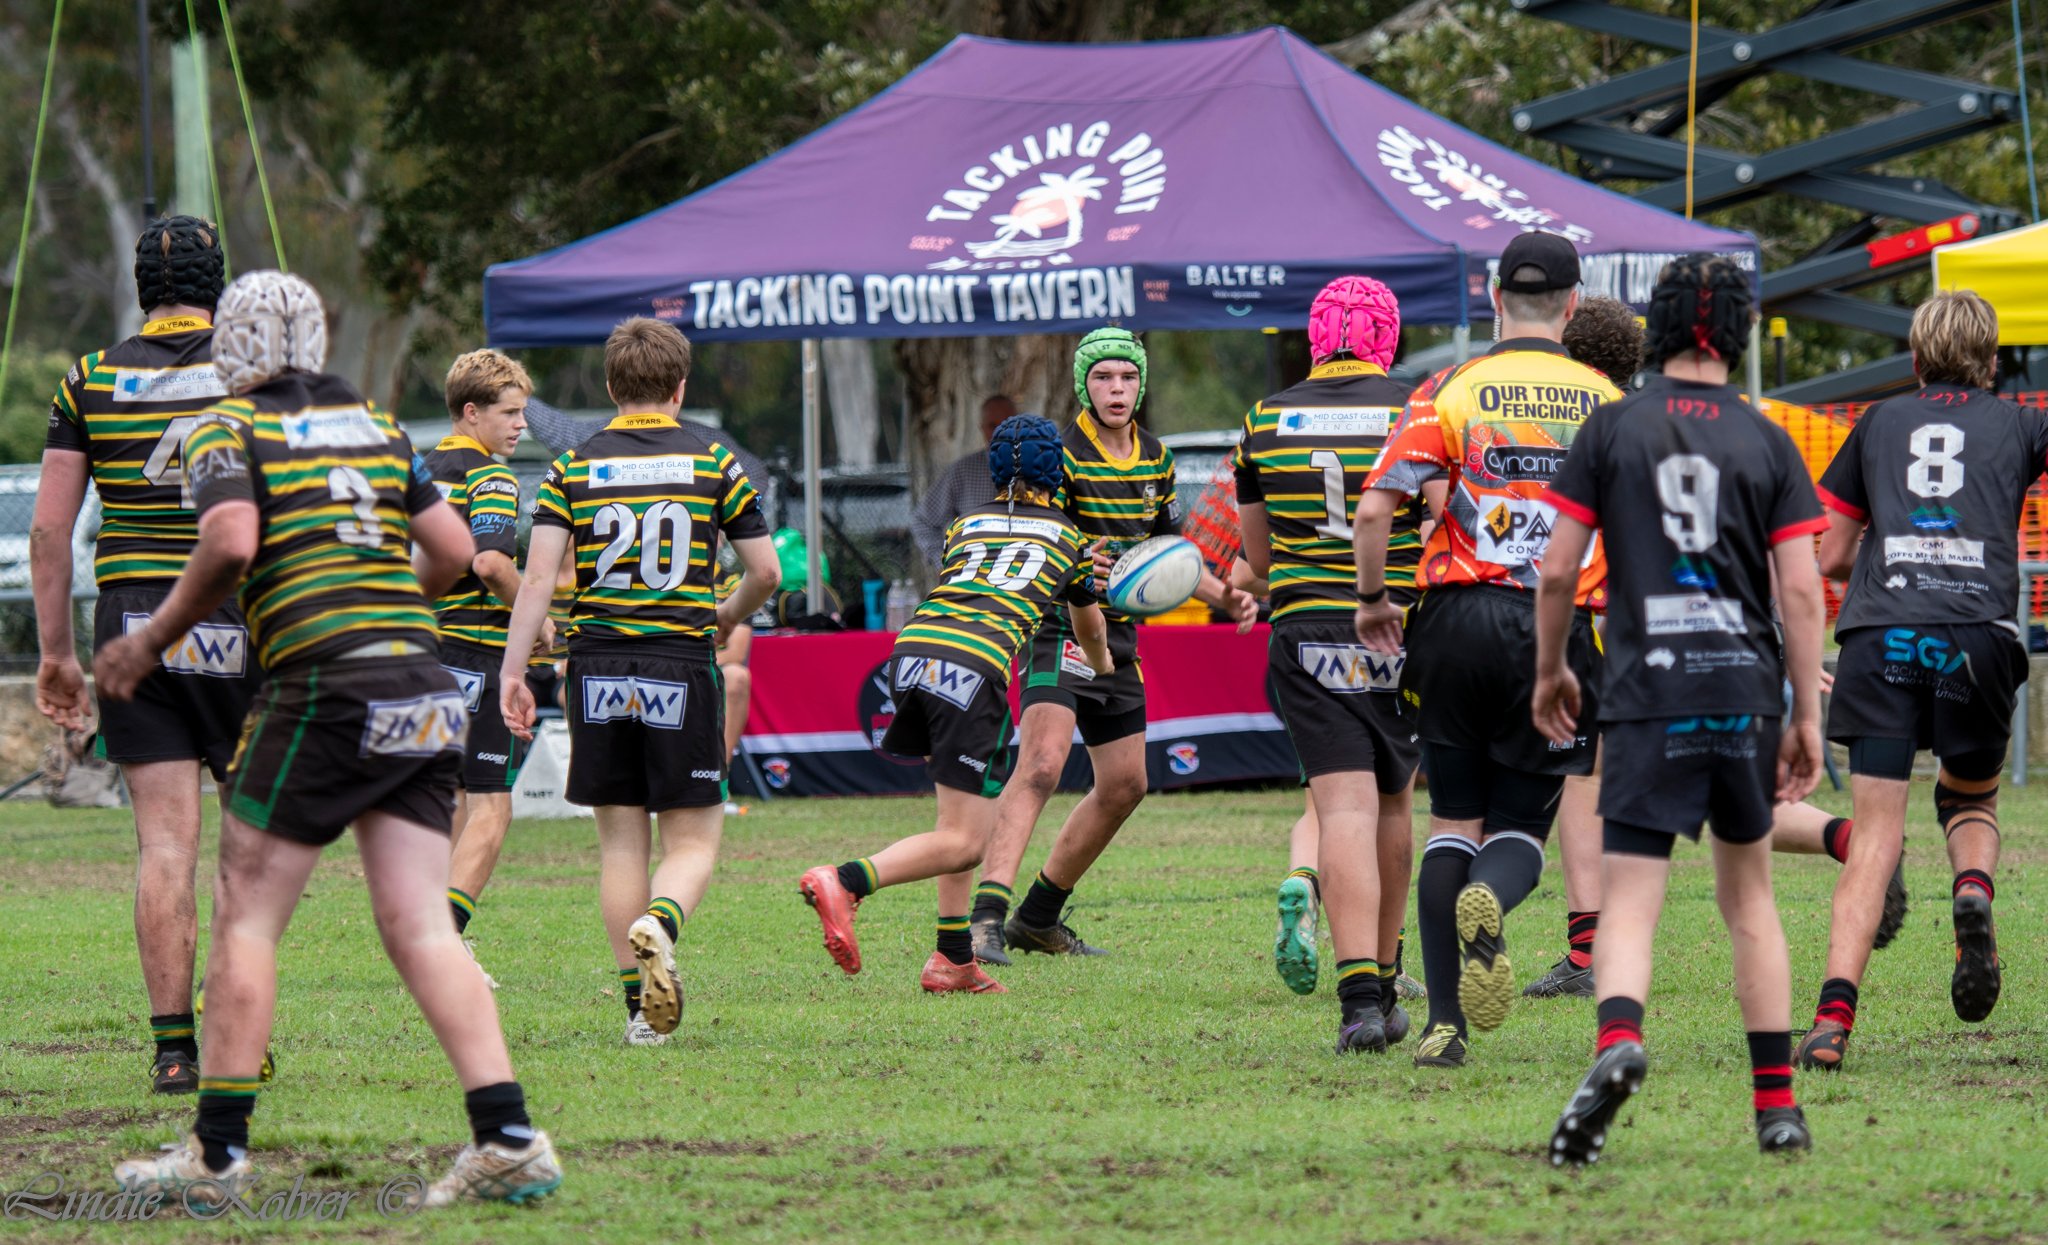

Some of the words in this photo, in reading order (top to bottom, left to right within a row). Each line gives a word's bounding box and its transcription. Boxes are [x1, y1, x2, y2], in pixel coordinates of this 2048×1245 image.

[926, 120, 1111, 222] TACKING
[1186, 264, 1286, 286] BALTER
[689, 272, 858, 329] TACKING
[863, 273, 980, 325] POINT
[986, 265, 1136, 322] TAVERN
[167, 320, 196, 329] YEARS
[197, 371, 215, 380] GLA
[1478, 385, 1528, 412] OUR
[1533, 386, 1600, 417] TOWN
[1502, 403, 1580, 422] FENCING
[1666, 396, 1721, 420] 1973
[1312, 423, 1386, 431] FENCING
[1360, 412, 1387, 420] GLASS
[1907, 423, 1965, 498] 8
[621, 471, 691, 481] FENCING
[1310, 450, 1354, 540] 1
[1657, 454, 1720, 553] 9
[327, 465, 384, 549] 3
[471, 513, 517, 534] phyxyo
[1510, 511, 1553, 542] PA
[590, 499, 693, 592] 20
[1915, 552, 1945, 560] METAL
[690, 769, 720, 779] GOOSE
